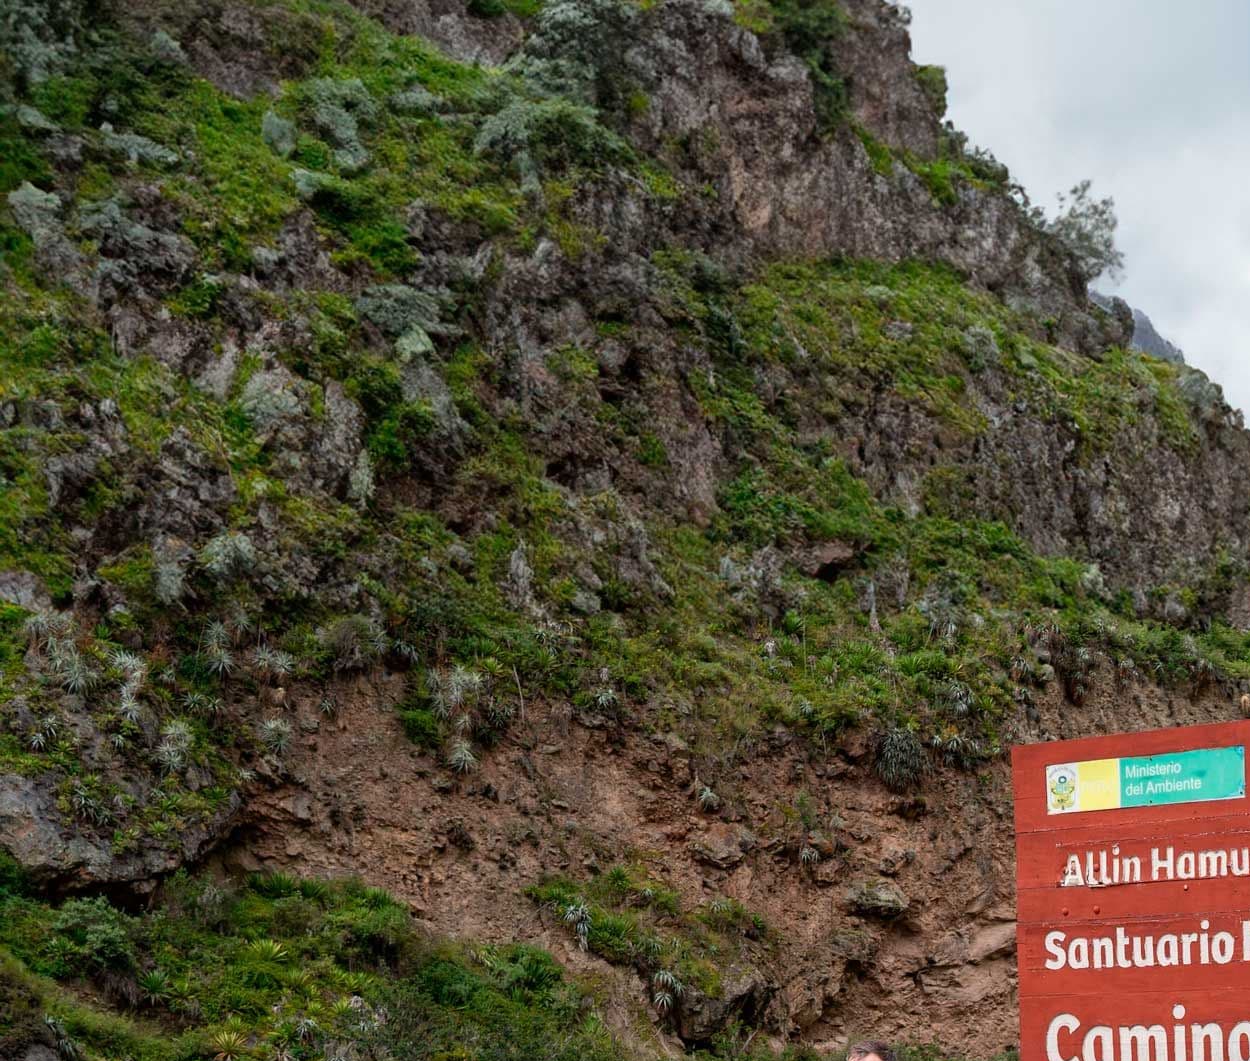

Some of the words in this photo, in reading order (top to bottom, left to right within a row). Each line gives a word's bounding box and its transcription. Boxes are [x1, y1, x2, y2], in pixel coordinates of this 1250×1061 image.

[1125, 760, 1182, 778] Ministerio
[1125, 781, 1144, 797] del
[1145, 776, 1202, 794] Ambiente
[1062, 844, 1141, 887] Allin
[1044, 919, 1235, 971] Santuario
